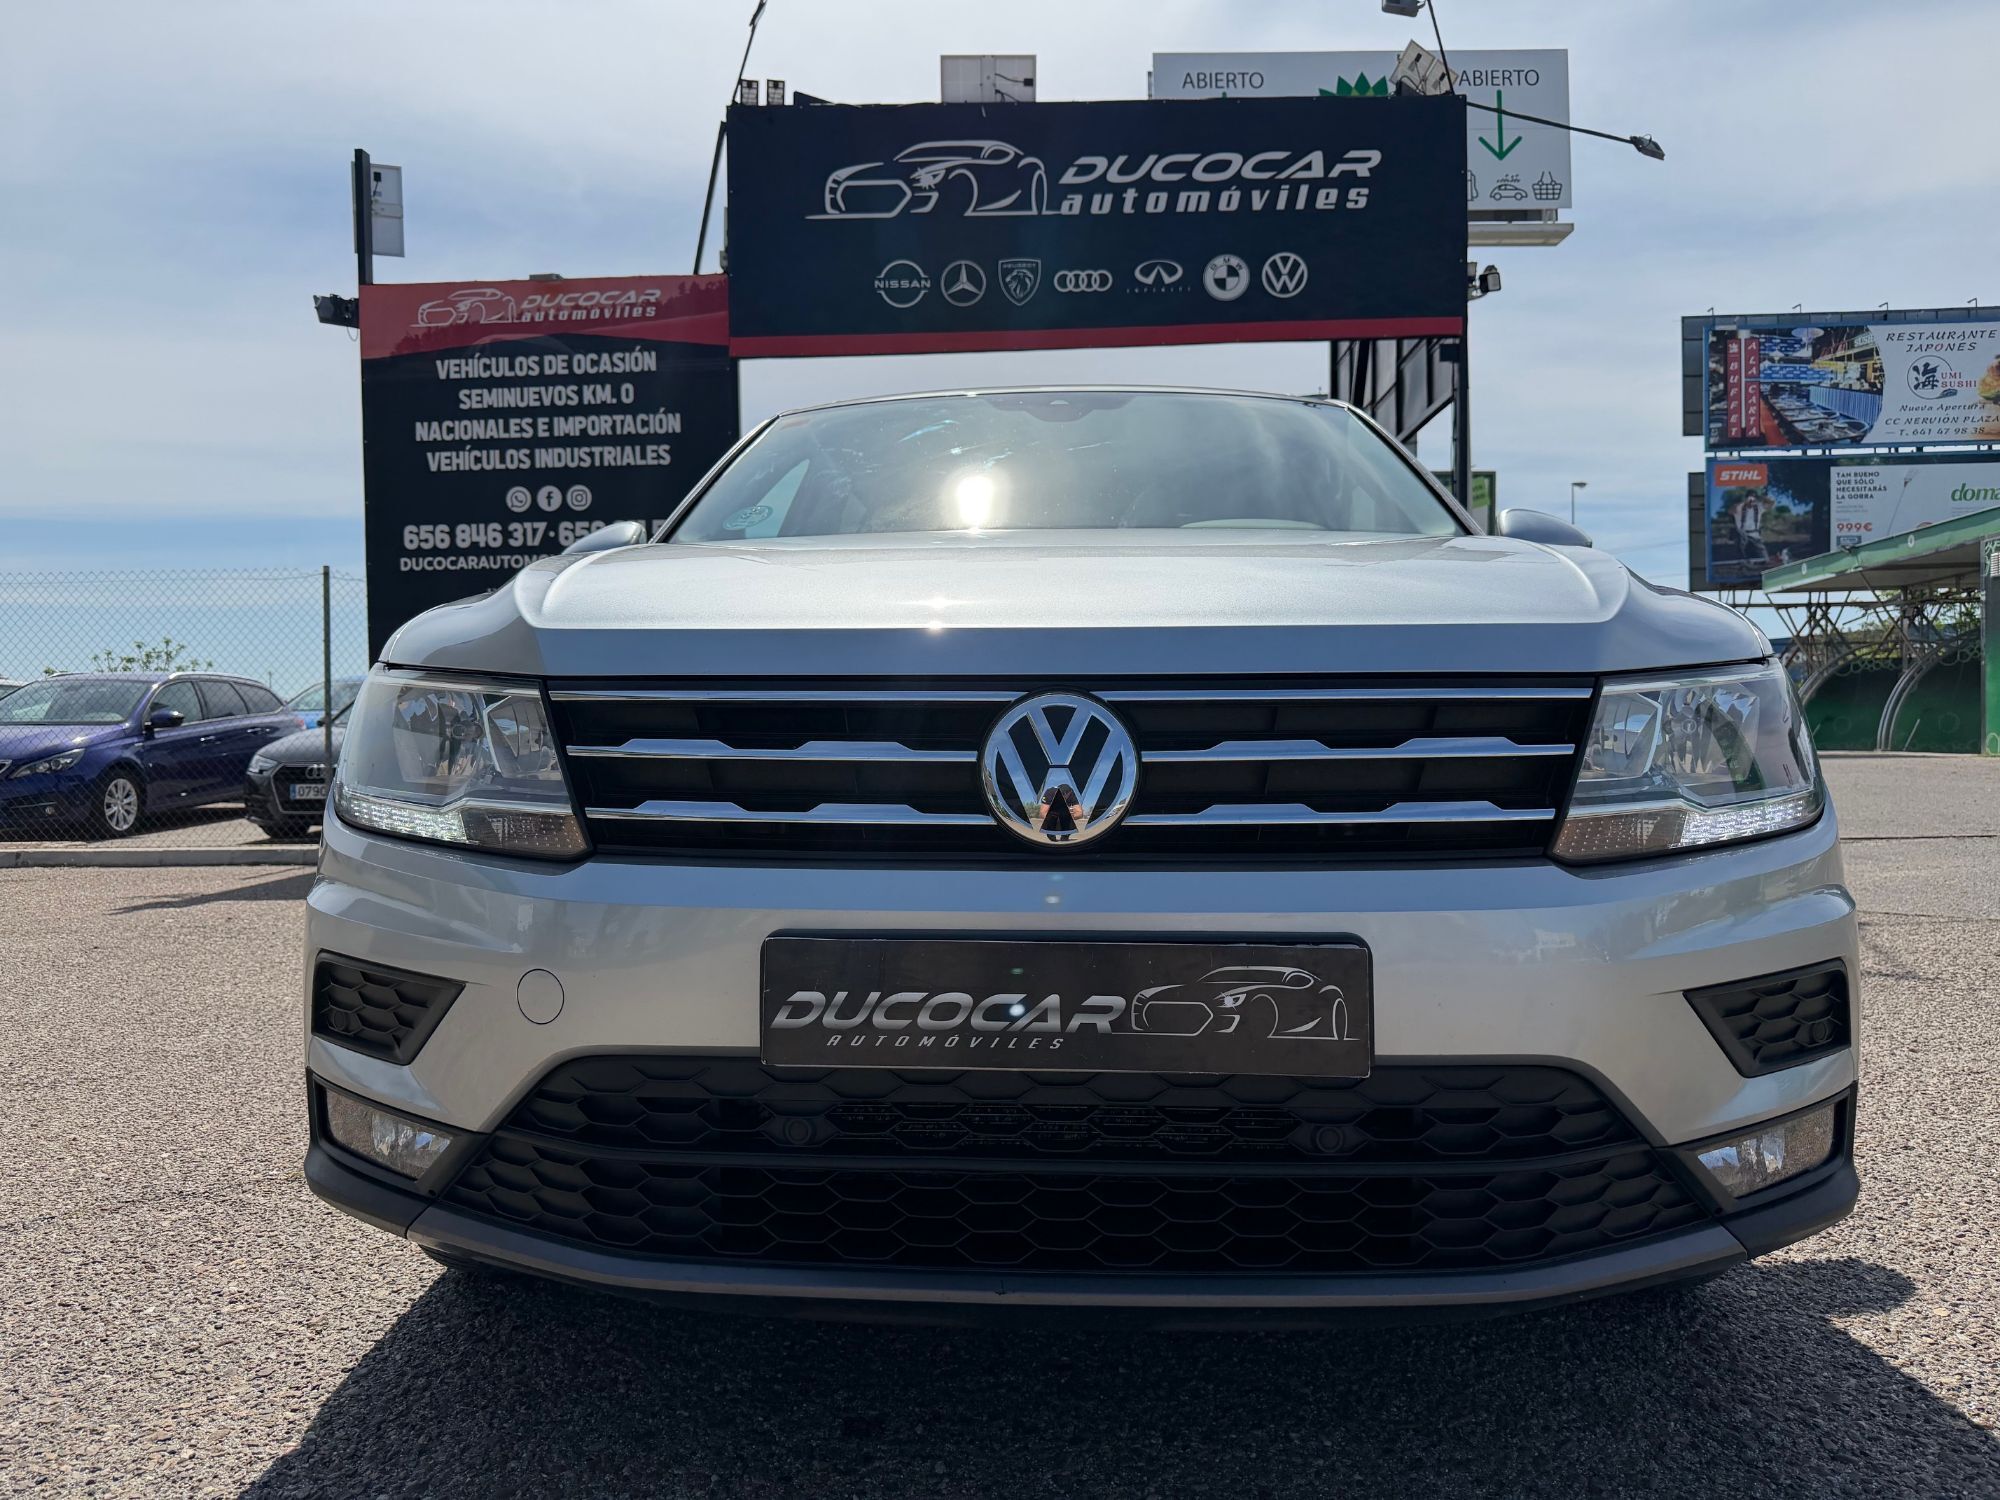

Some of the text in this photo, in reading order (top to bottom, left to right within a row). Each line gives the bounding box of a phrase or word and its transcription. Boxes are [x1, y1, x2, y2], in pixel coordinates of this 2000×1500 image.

[1182, 72, 1264, 89] ABIERTO
[1459, 70, 1539, 87] ABIERTO
[1058, 150, 1382, 184] DUCOCAR
[1060, 184, 1369, 215] automóviles
[874, 279, 931, 289] NISSAN
[521, 289, 661, 308] DUCOCAR
[1886, 330, 1997, 341] RESTAURANTE
[1906, 342, 1977, 352] JAPONES
[436, 346, 657, 380] VEHÍCULOS DE OCASIÓN
[458, 385, 578, 410] SEMINUEVOS
[583, 384, 617, 405] KM.
[1936, 403, 1985, 413] Apertura
[415, 407, 681, 441] NACIONALES E IMPORTACIÓN
[1963, 415, 2000, 423] PLAZA
[427, 444, 670, 472] VEHÍCULOS INDUSTRIALES
[1719, 470, 1762, 481] STIHL
[1836, 522, 1873, 532] 999€
[403, 525, 450, 550] 656
[455, 522, 502, 548] 846
[770, 991, 1127, 1033] DUCOCAR
[826, 1033, 1065, 1050] AUTOMÓVILES
